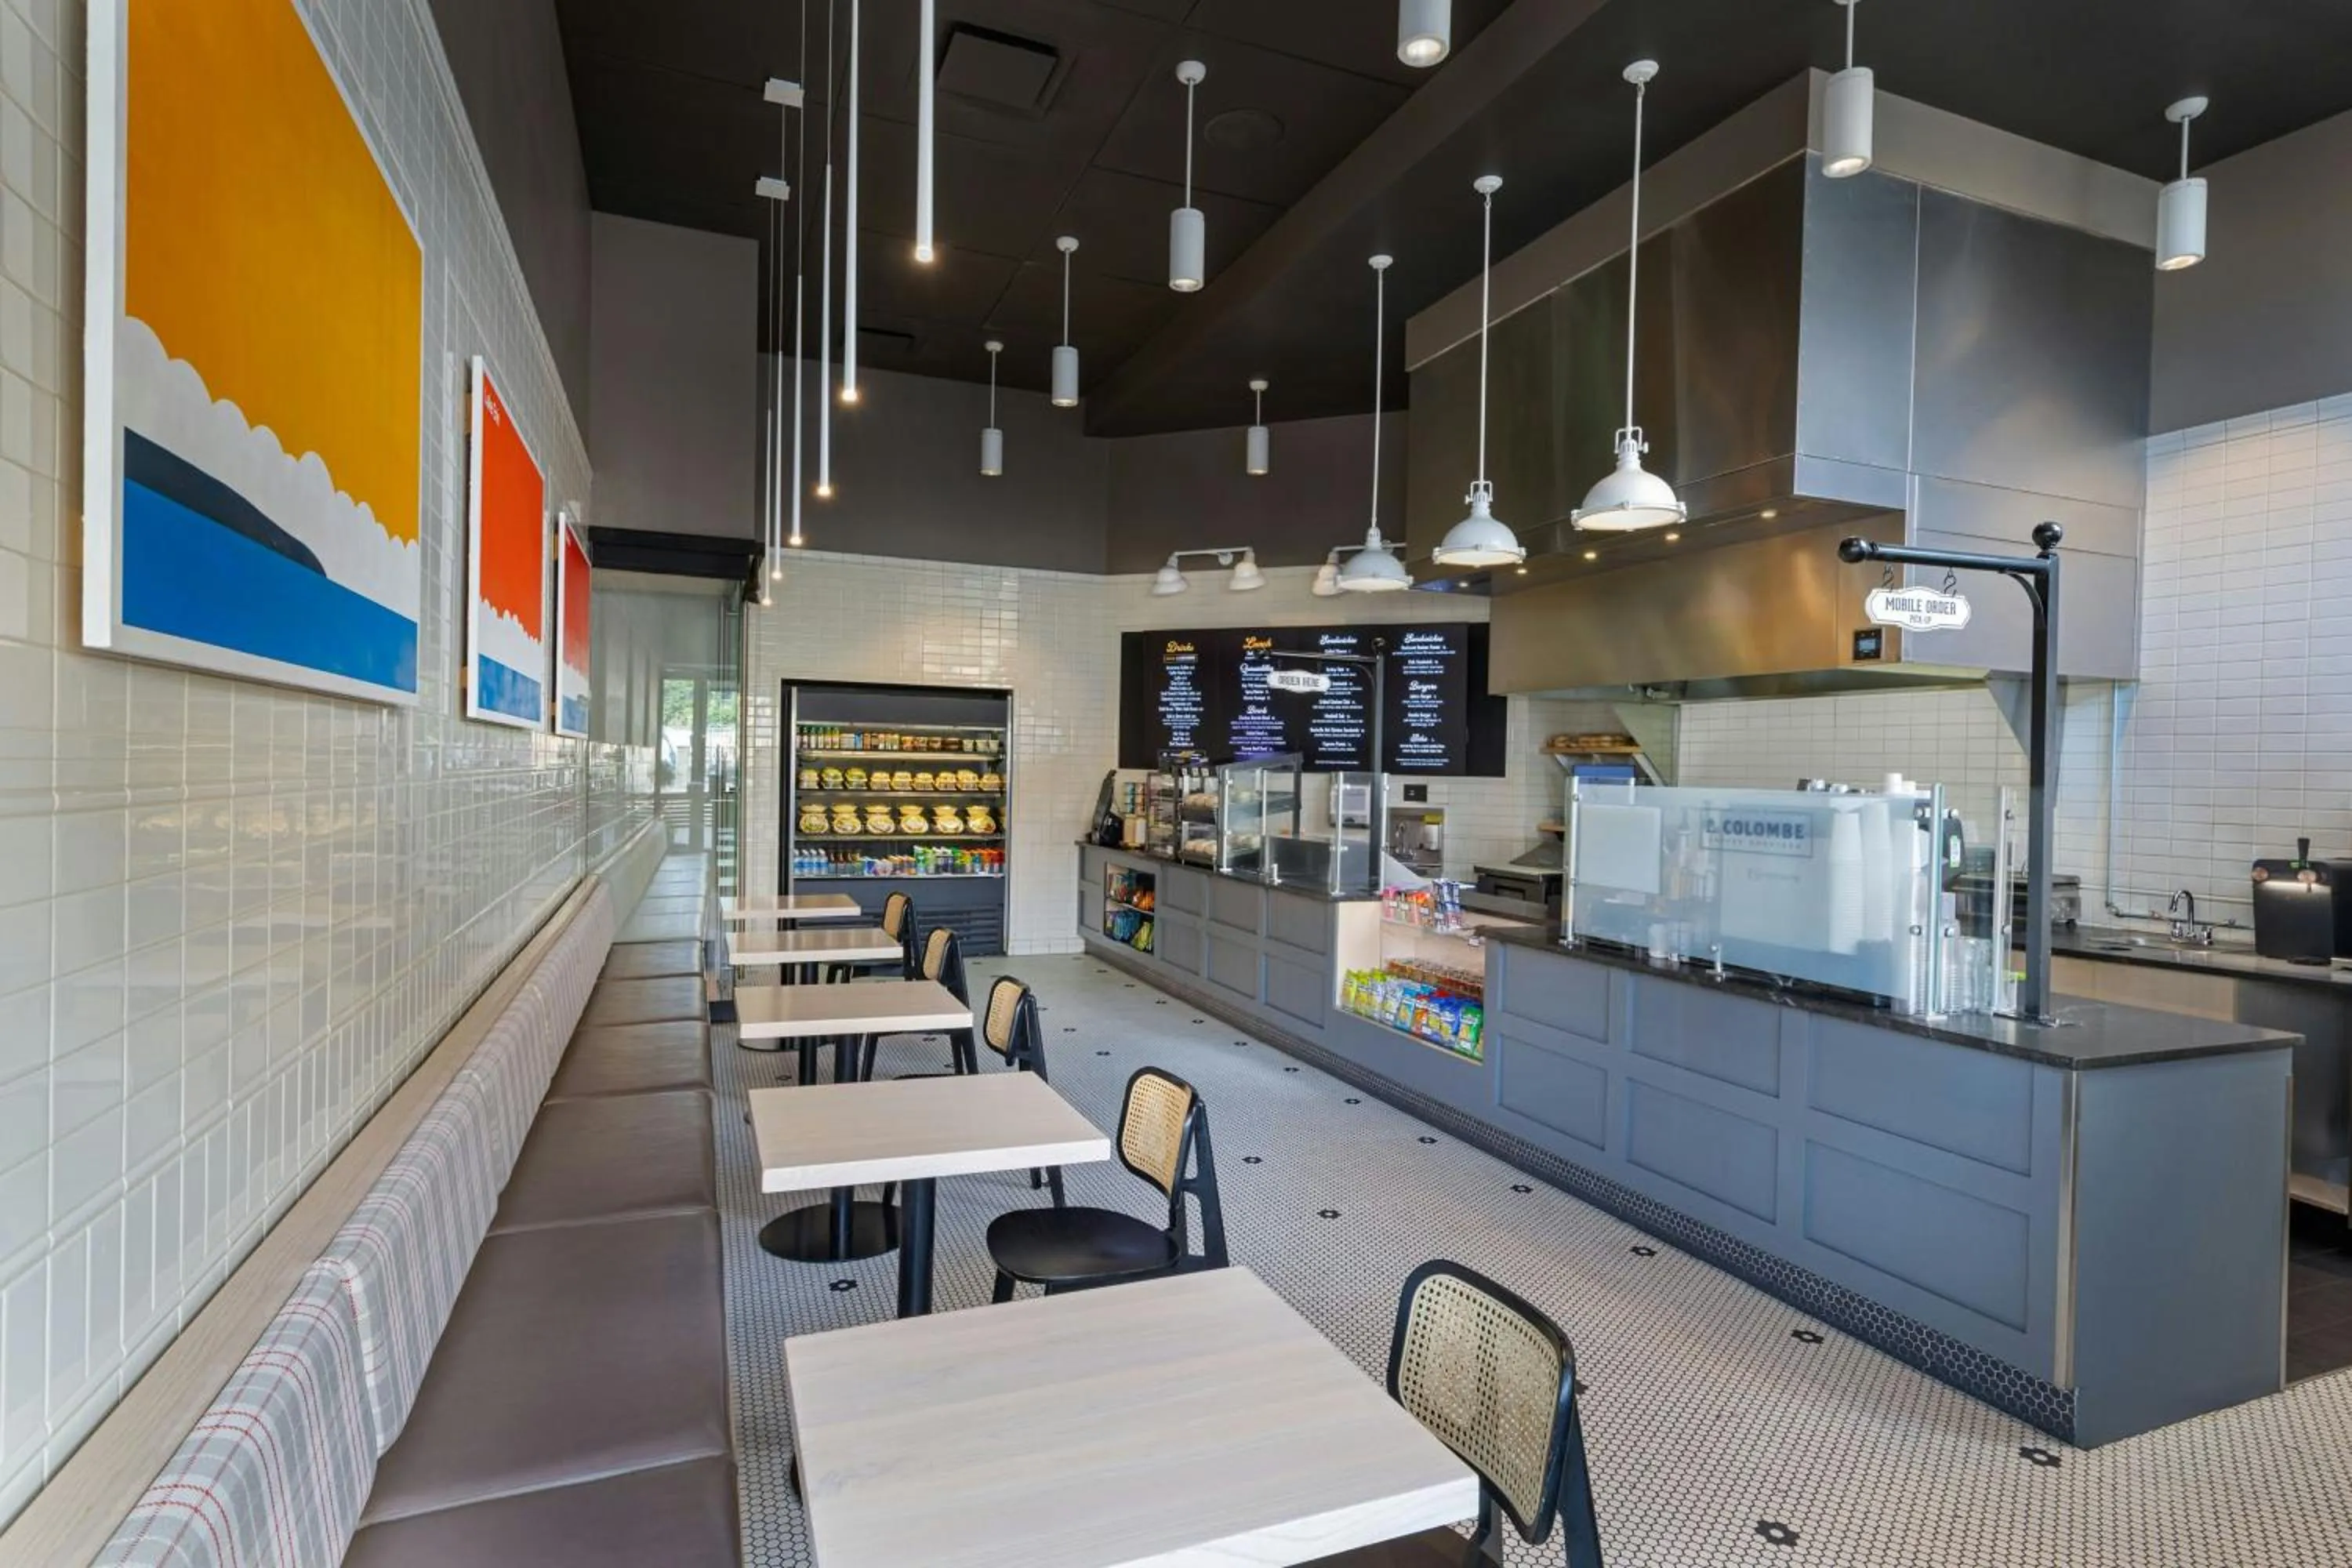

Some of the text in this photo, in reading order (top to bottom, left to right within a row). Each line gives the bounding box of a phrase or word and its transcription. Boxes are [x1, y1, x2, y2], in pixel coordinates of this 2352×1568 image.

[1885, 597, 1957, 615] MOBILE ORDER
[1166, 640, 1195, 653] Drinks
[1722, 819, 1806, 840] COLOMBE
